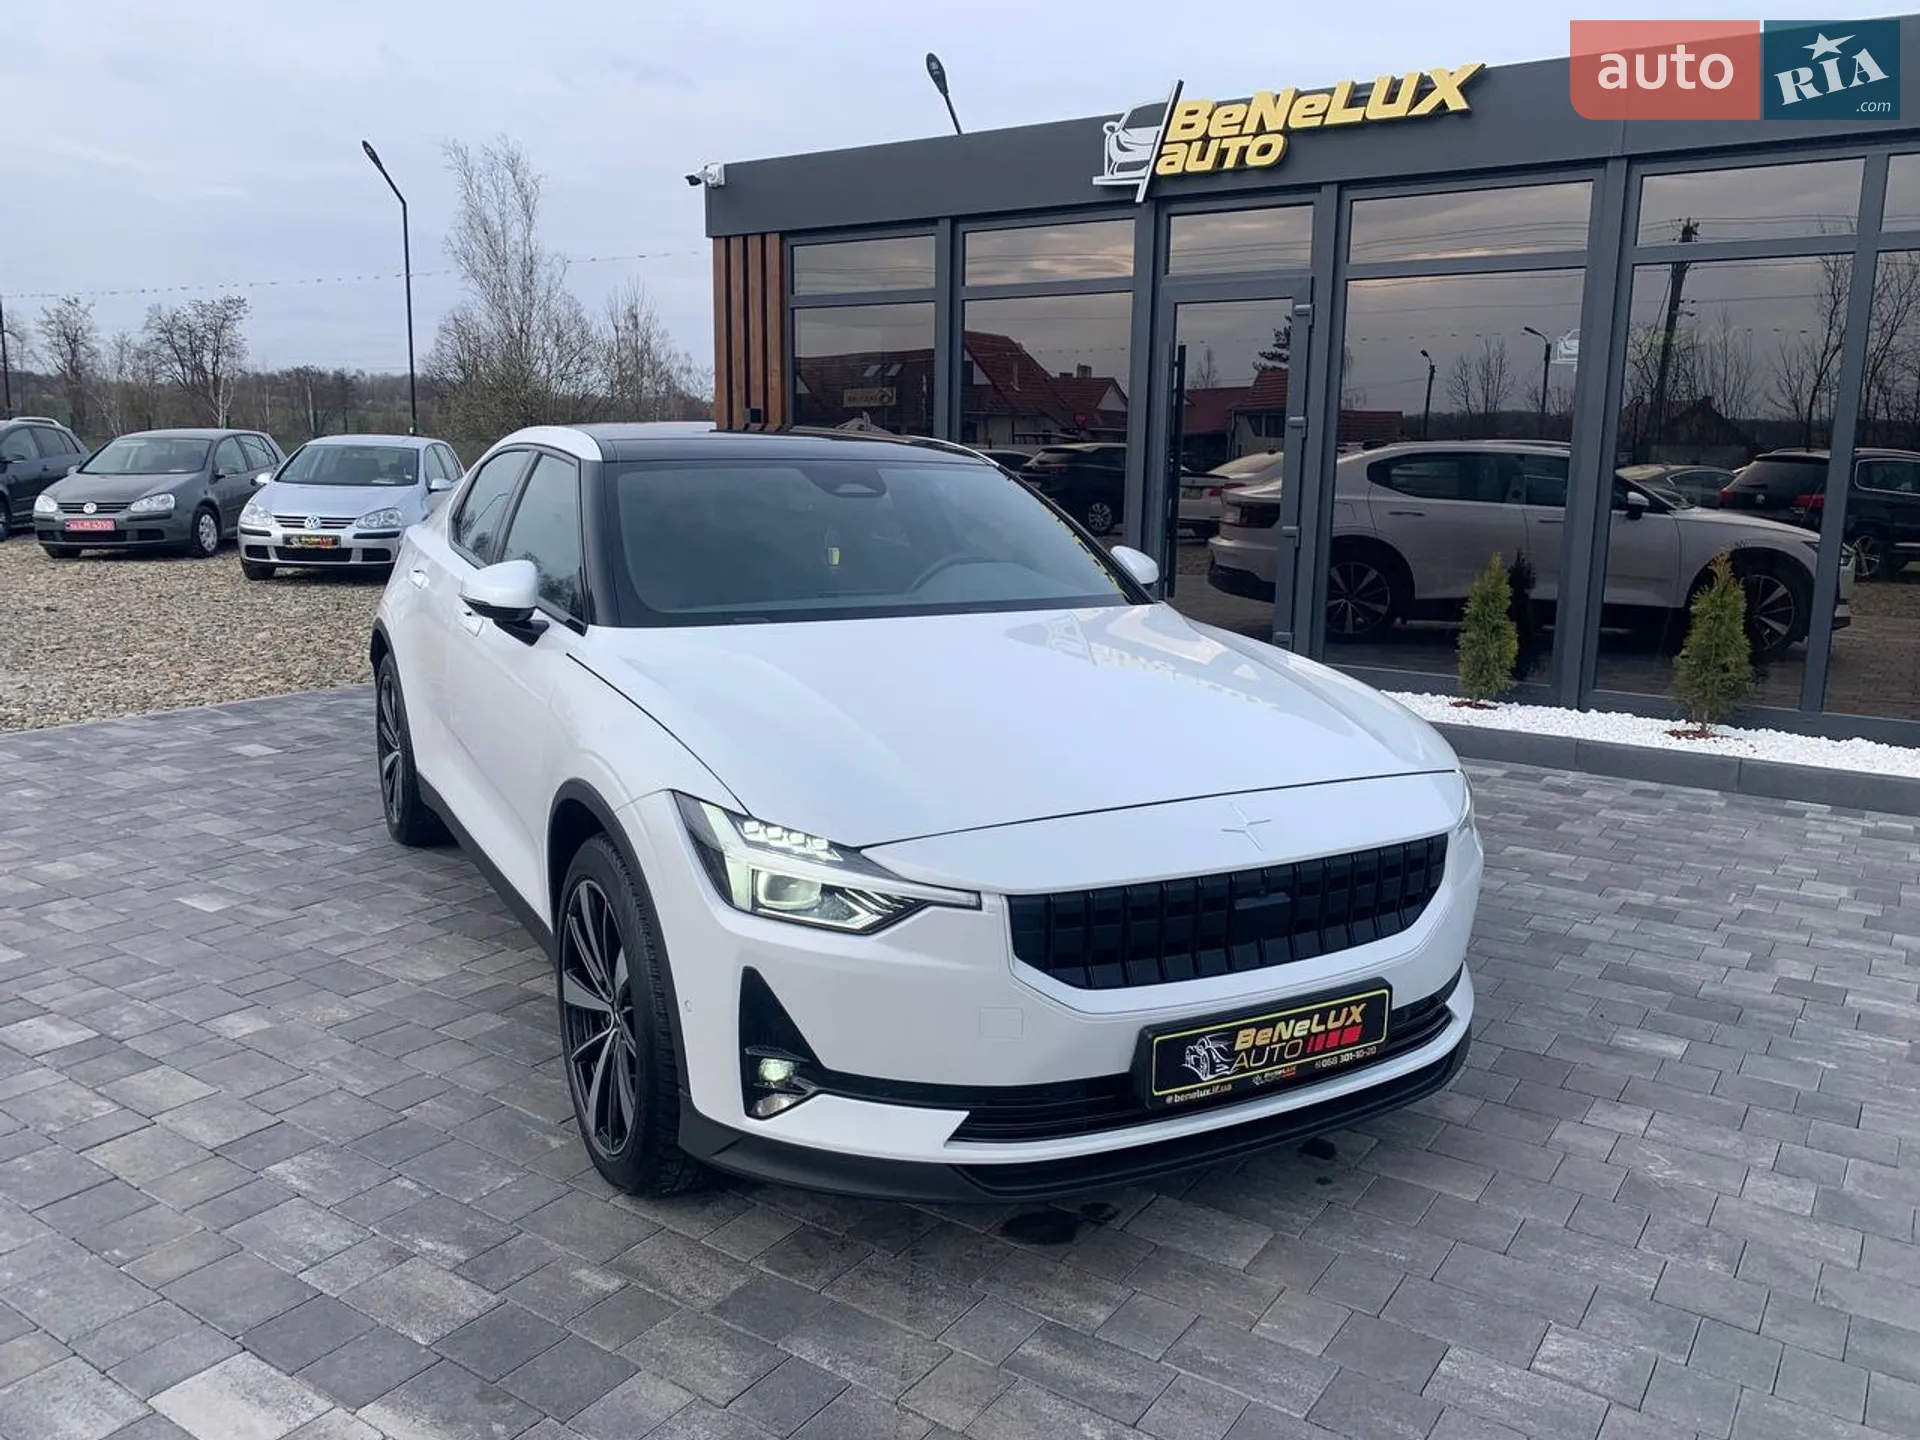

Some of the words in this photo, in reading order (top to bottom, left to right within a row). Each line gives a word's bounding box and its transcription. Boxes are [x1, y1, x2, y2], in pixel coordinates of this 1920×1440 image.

[1164, 62, 1487, 144] BeNeLUX
[1234, 1002, 1367, 1052] BeNeLUX
[1230, 1038, 1304, 1074] AUTO
